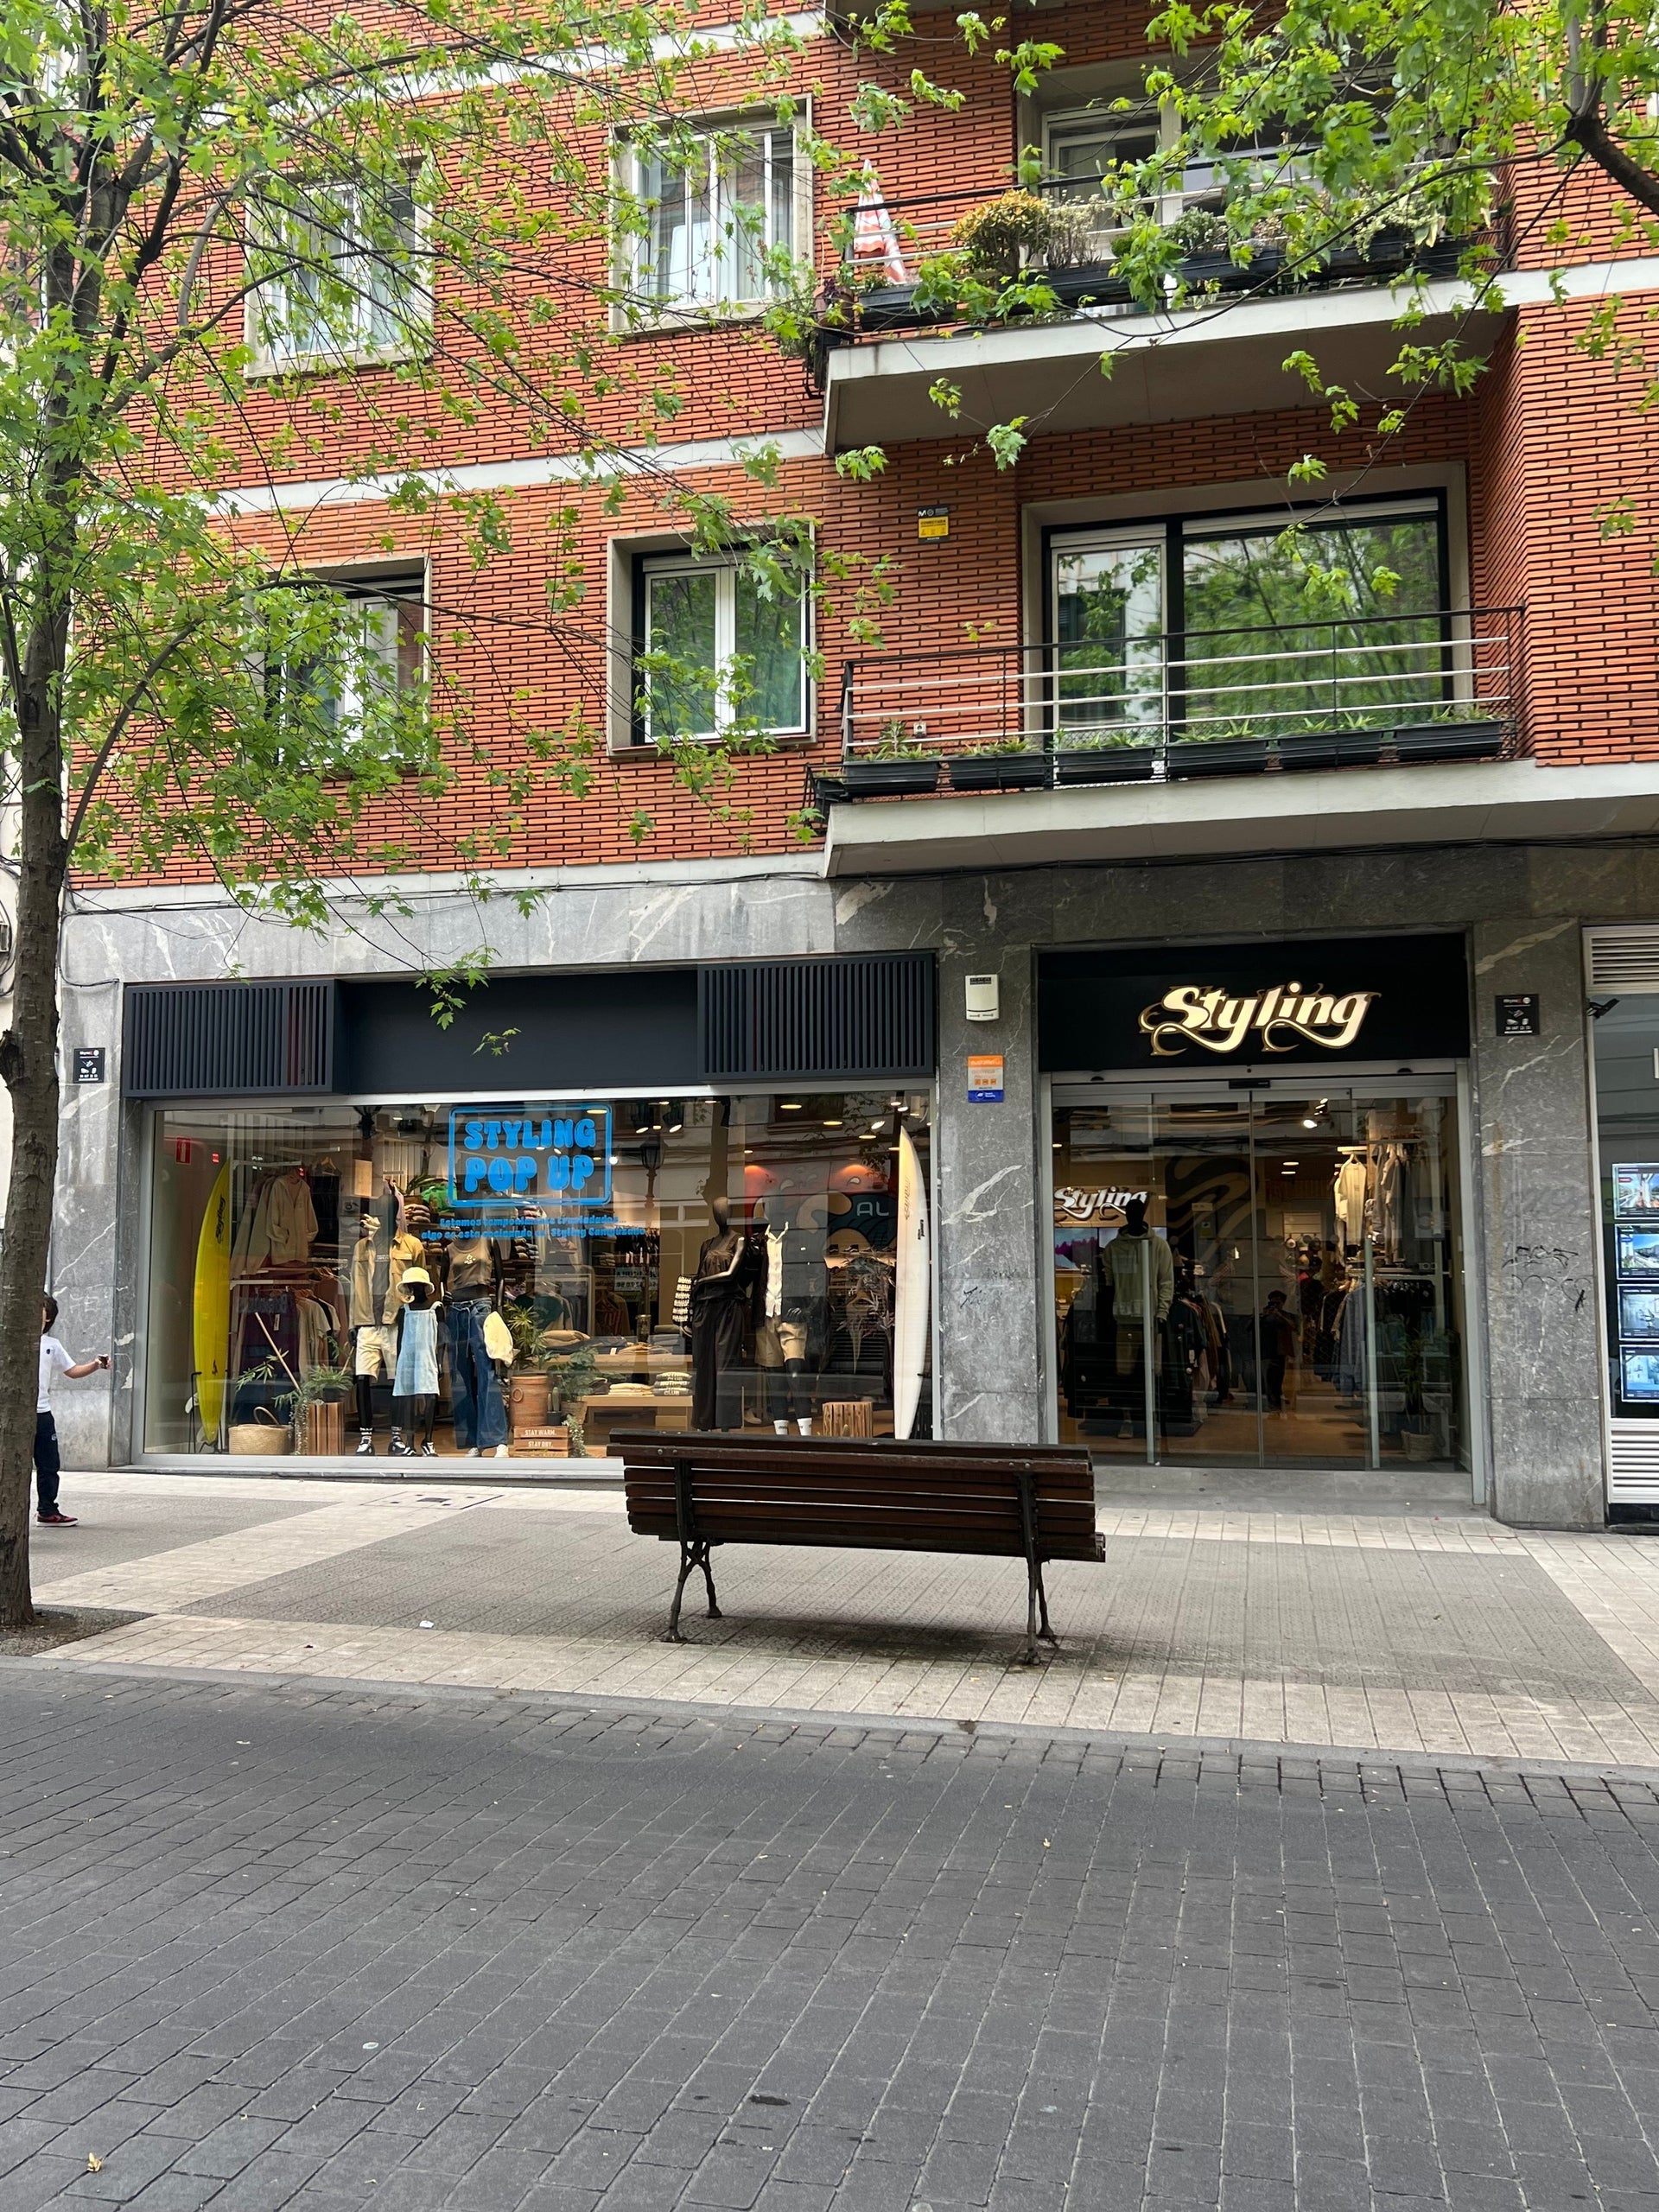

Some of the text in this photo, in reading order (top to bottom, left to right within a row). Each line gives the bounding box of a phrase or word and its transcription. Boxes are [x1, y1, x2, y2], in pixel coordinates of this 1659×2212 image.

[1138, 980, 1381, 1057] Styling
[464, 1118, 596, 1150] STYLING
[464, 1154, 594, 1192] POP UP
[421, 1230, 443, 1242] algo
[550, 1227, 587, 1238] Styling
